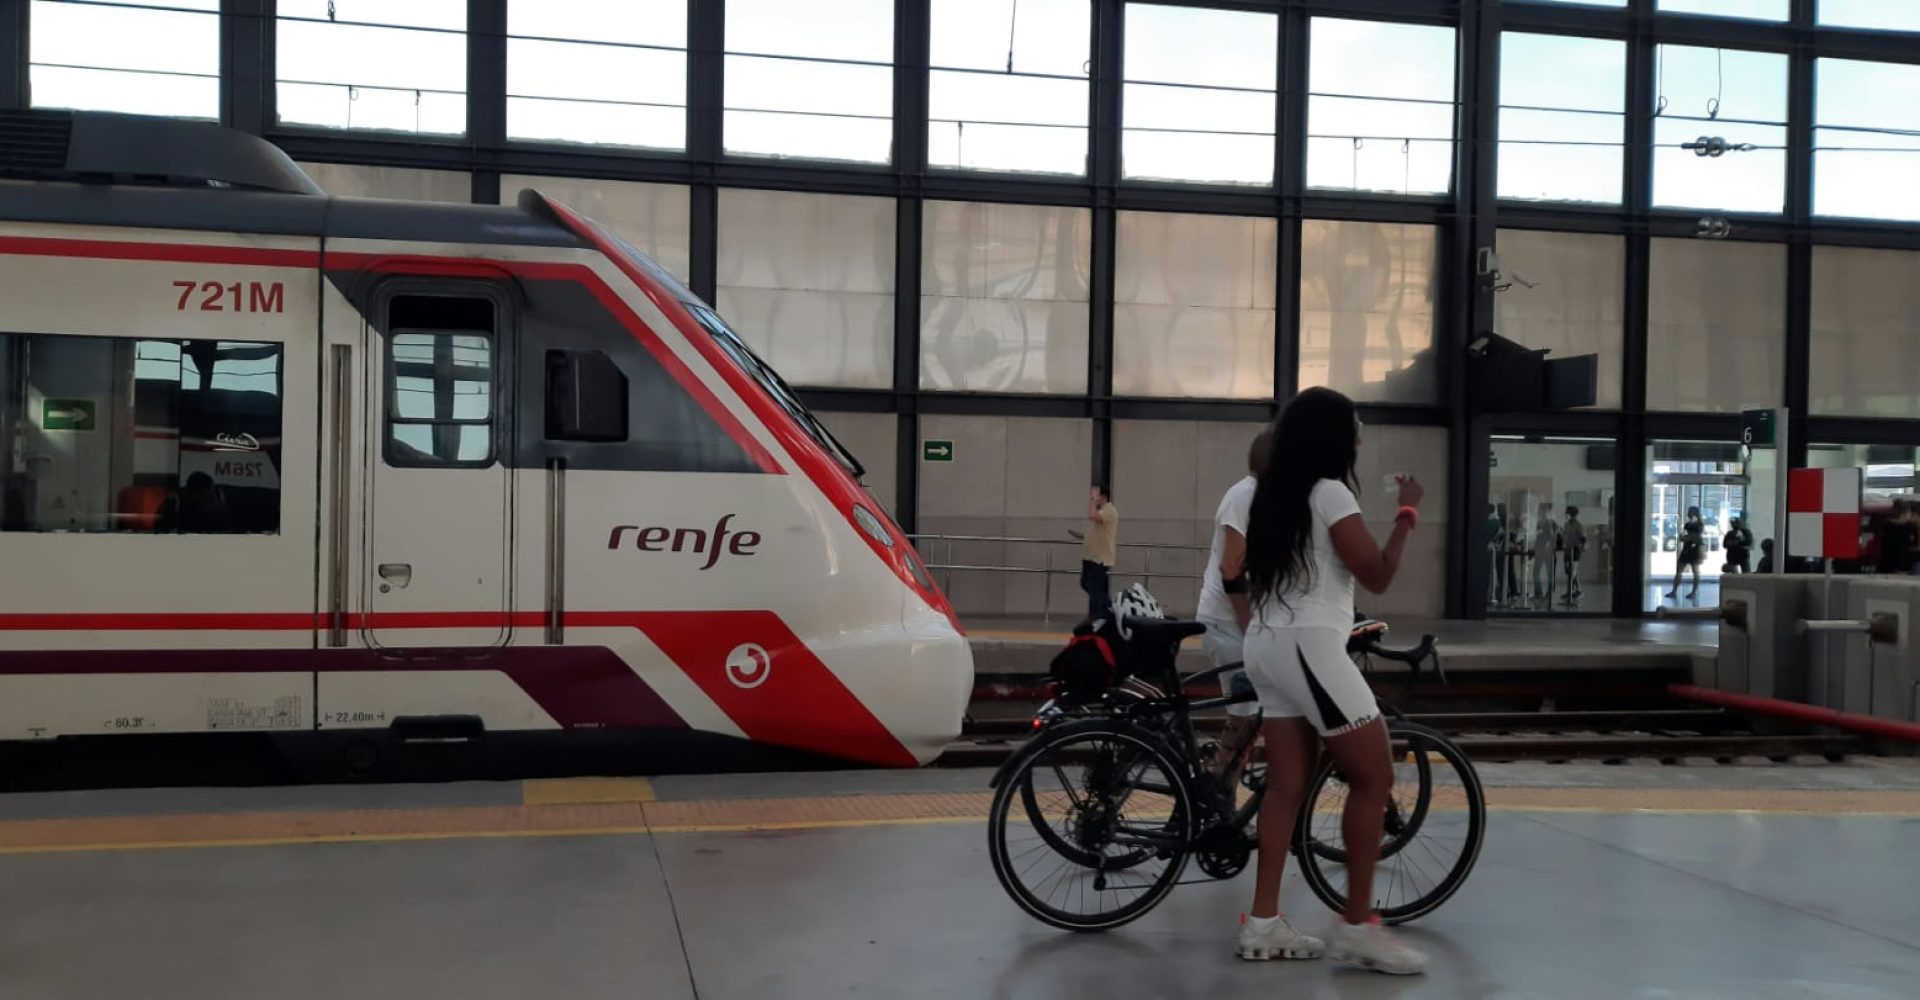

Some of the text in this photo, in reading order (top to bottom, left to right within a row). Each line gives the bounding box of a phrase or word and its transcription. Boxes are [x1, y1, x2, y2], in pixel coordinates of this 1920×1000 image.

[173, 281, 284, 313] 721M
[1744, 427, 1752, 443] 6
[607, 513, 762, 571] renfe
